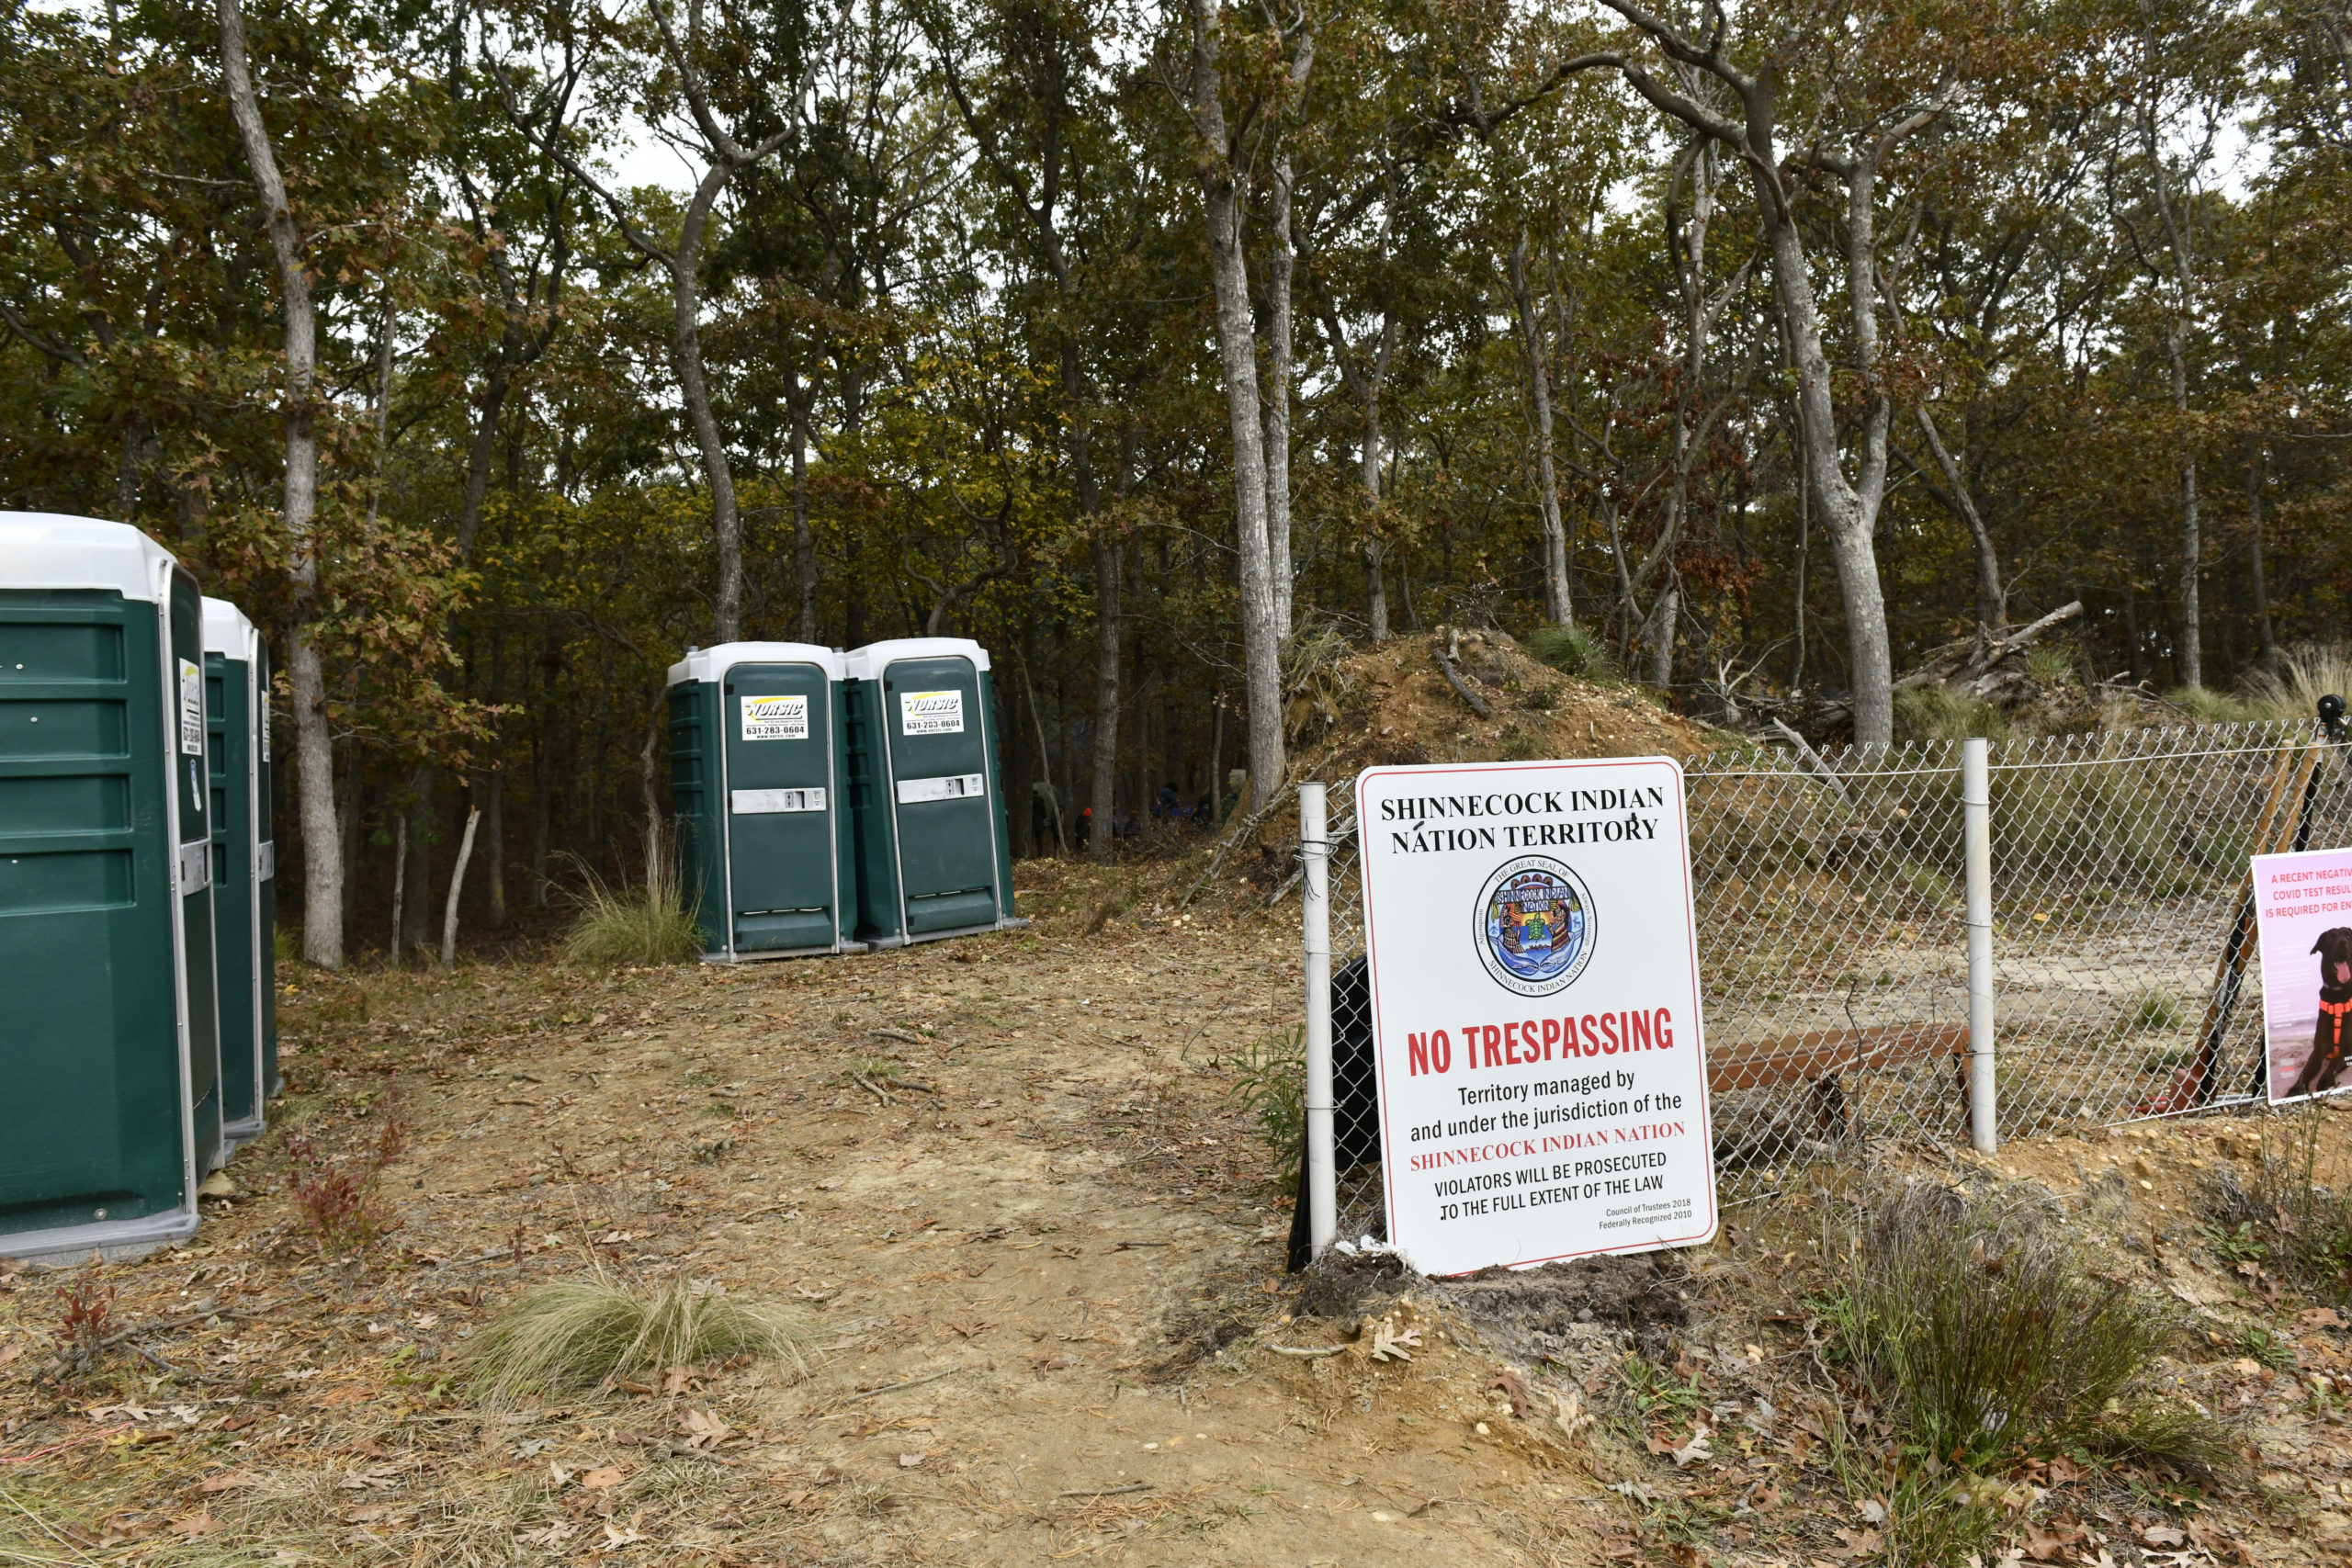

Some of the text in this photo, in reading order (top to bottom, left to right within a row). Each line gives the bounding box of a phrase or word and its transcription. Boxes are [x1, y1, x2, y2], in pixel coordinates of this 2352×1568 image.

[1381, 786, 1663, 821] SHINNECOCK INDIAN
[1391, 818, 1658, 853] NATION TERRITORY
[1494, 860, 1570, 884] THE GREAT SEAL OF
[2271, 874, 2278, 884] A
[2280, 872, 2314, 883] RECENT
[1498, 887, 1569, 903] SHINNECOCK INDIAN
[1522, 901, 1550, 911] NATION
[2266, 901, 2352, 918] IS REQUIRED FOR EN
[2273, 884, 2352, 900] COVID TEST RESUL
[1489, 951, 1588, 992] SHINNECOCK INDIAN NATION
[1408, 1007, 1674, 1077] NO TRESPASSING
[1458, 1070, 1635, 1106] Territory managed by
[1410, 1093, 1682, 1143] and under the jurisdiction of the
[1409, 1121, 1685, 1172] SHINNECOCK INDIAN NATION
[1434, 1152, 1667, 1198] VIOLATORS WILL BE PROSECUTED
[1441, 1175, 1663, 1221] TO THE FULL EXTENT OF THE LAW
[1606, 1198, 1690, 1216] Council of Trustees 2018
[1599, 1210, 1692, 1229] Federally Recognized 2010
